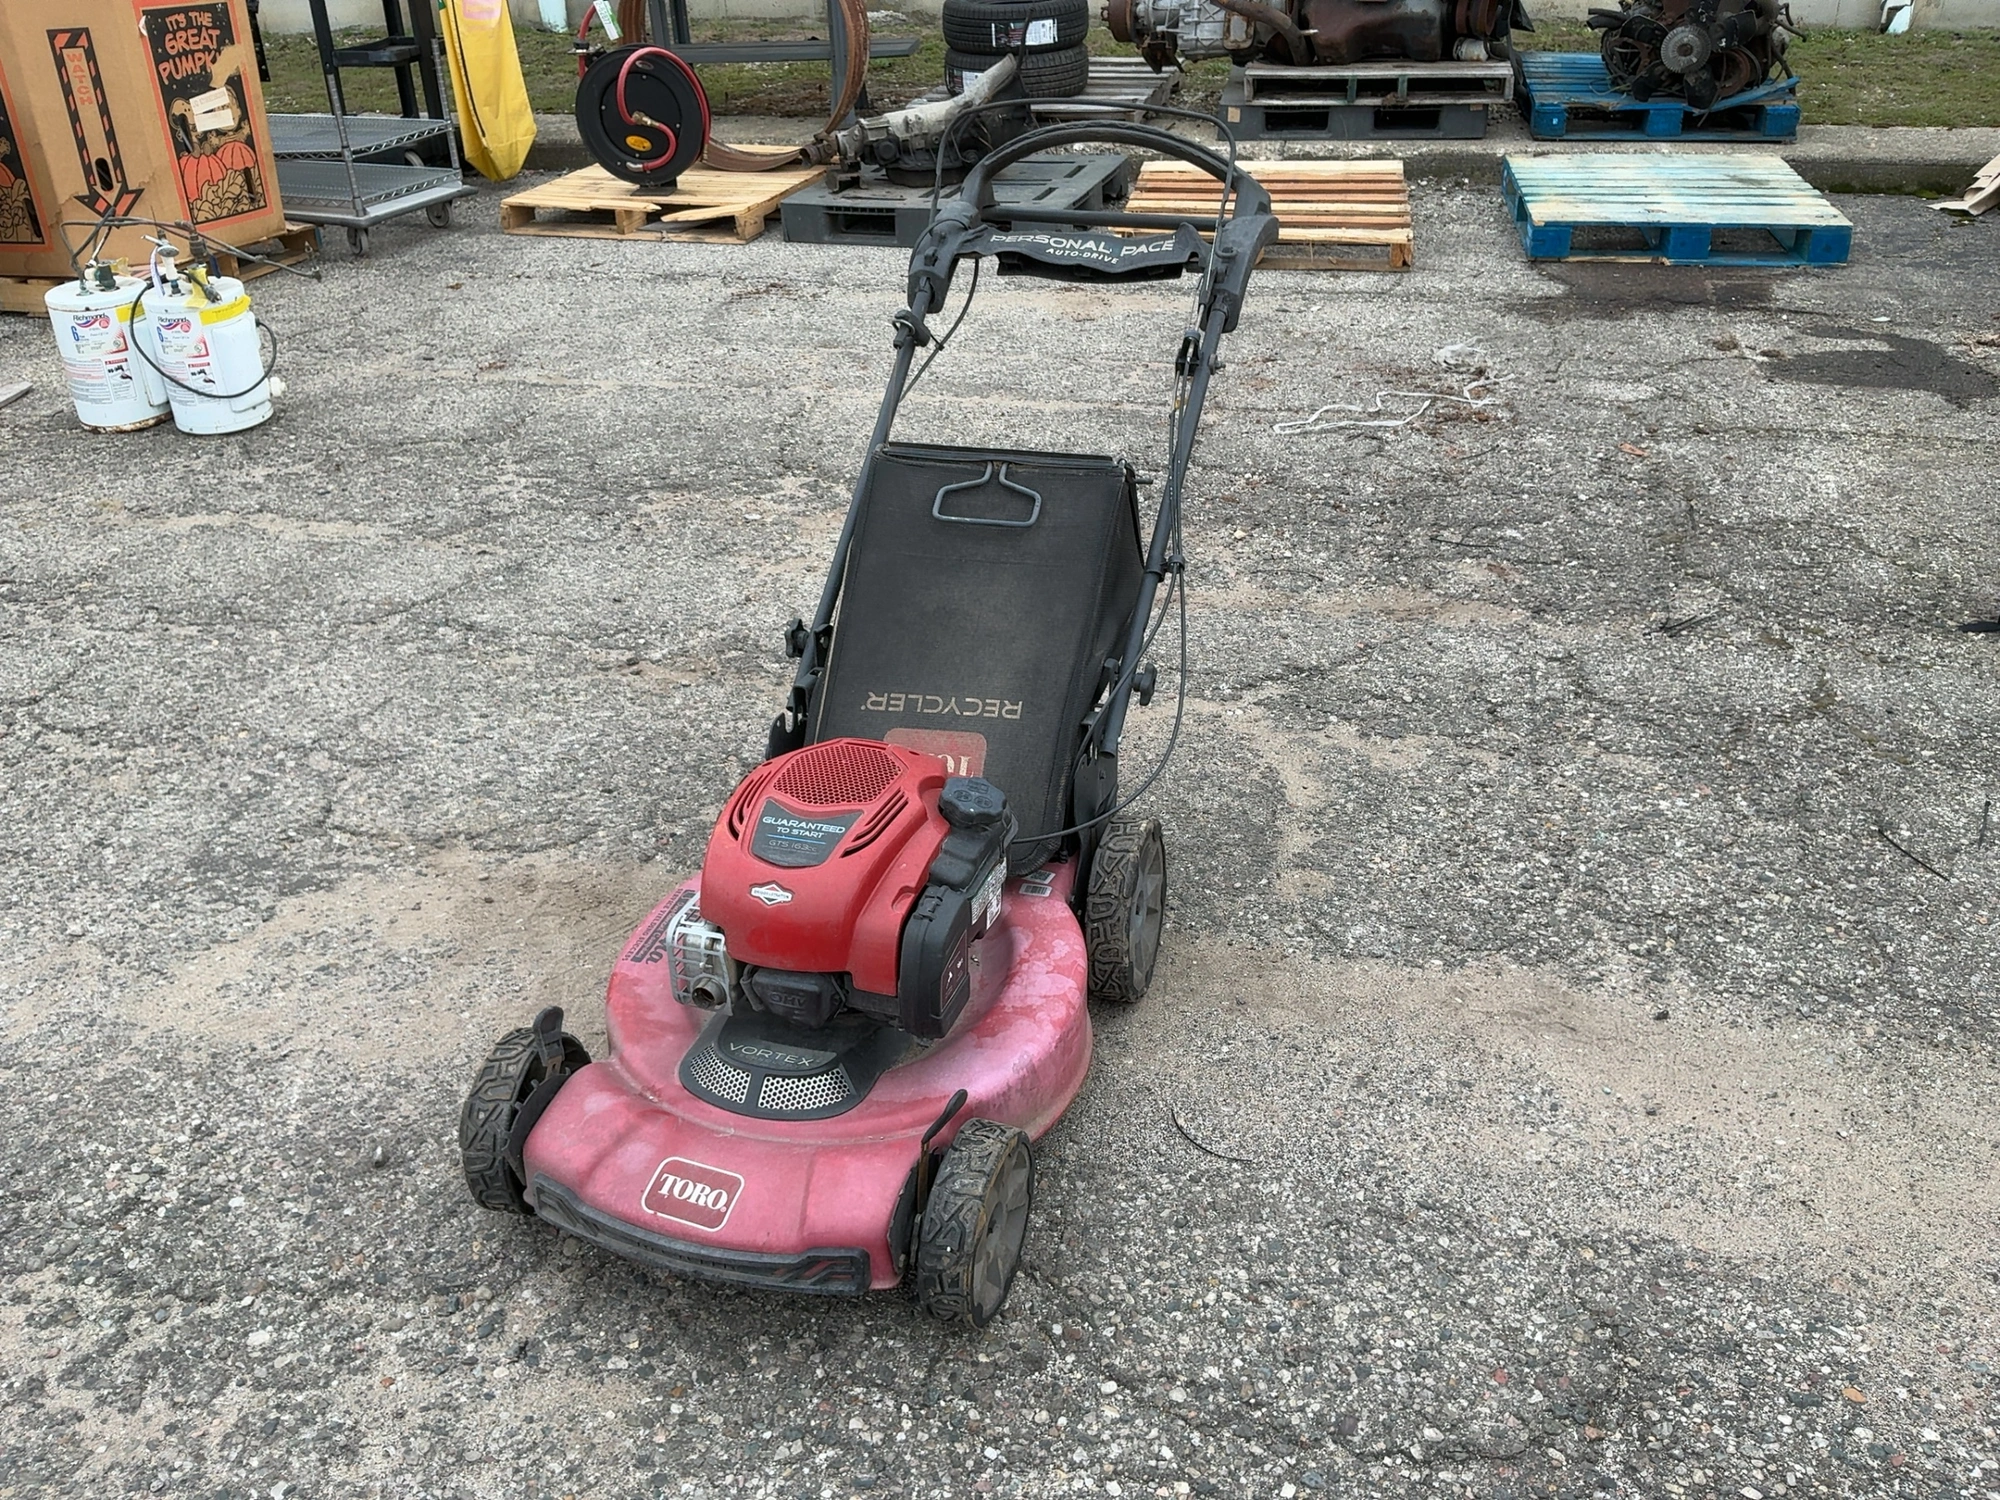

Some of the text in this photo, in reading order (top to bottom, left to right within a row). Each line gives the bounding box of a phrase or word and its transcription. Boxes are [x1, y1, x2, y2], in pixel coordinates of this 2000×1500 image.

[165, 11, 213, 31] IT'S THE
[165, 27, 220, 55] GREAT
[65, 53, 94, 105] WATCH
[158, 50, 222, 85] PUMPK
[990, 234, 1175, 257] PERSONAL PACE
[1045, 248, 1119, 265] AUTO-DRIVE
[73, 312, 106, 321] Richmond
[157, 316, 188, 324] Richmond
[71, 325, 80, 342] 6
[156, 326, 165, 343] 6
[864, 691, 1023, 719] RECYCLER
[762, 816, 846, 834] GUARANTEED
[776, 826, 825, 839] TO START
[768, 839, 789, 848] GTS
[663, 887, 684, 910] SERVICE
[642, 909, 666, 936] YIELDING
[622, 936, 645, 962] SUCCESS
[730, 1043, 814, 1067] VORTEX
[657, 1173, 729, 1211] TORO
